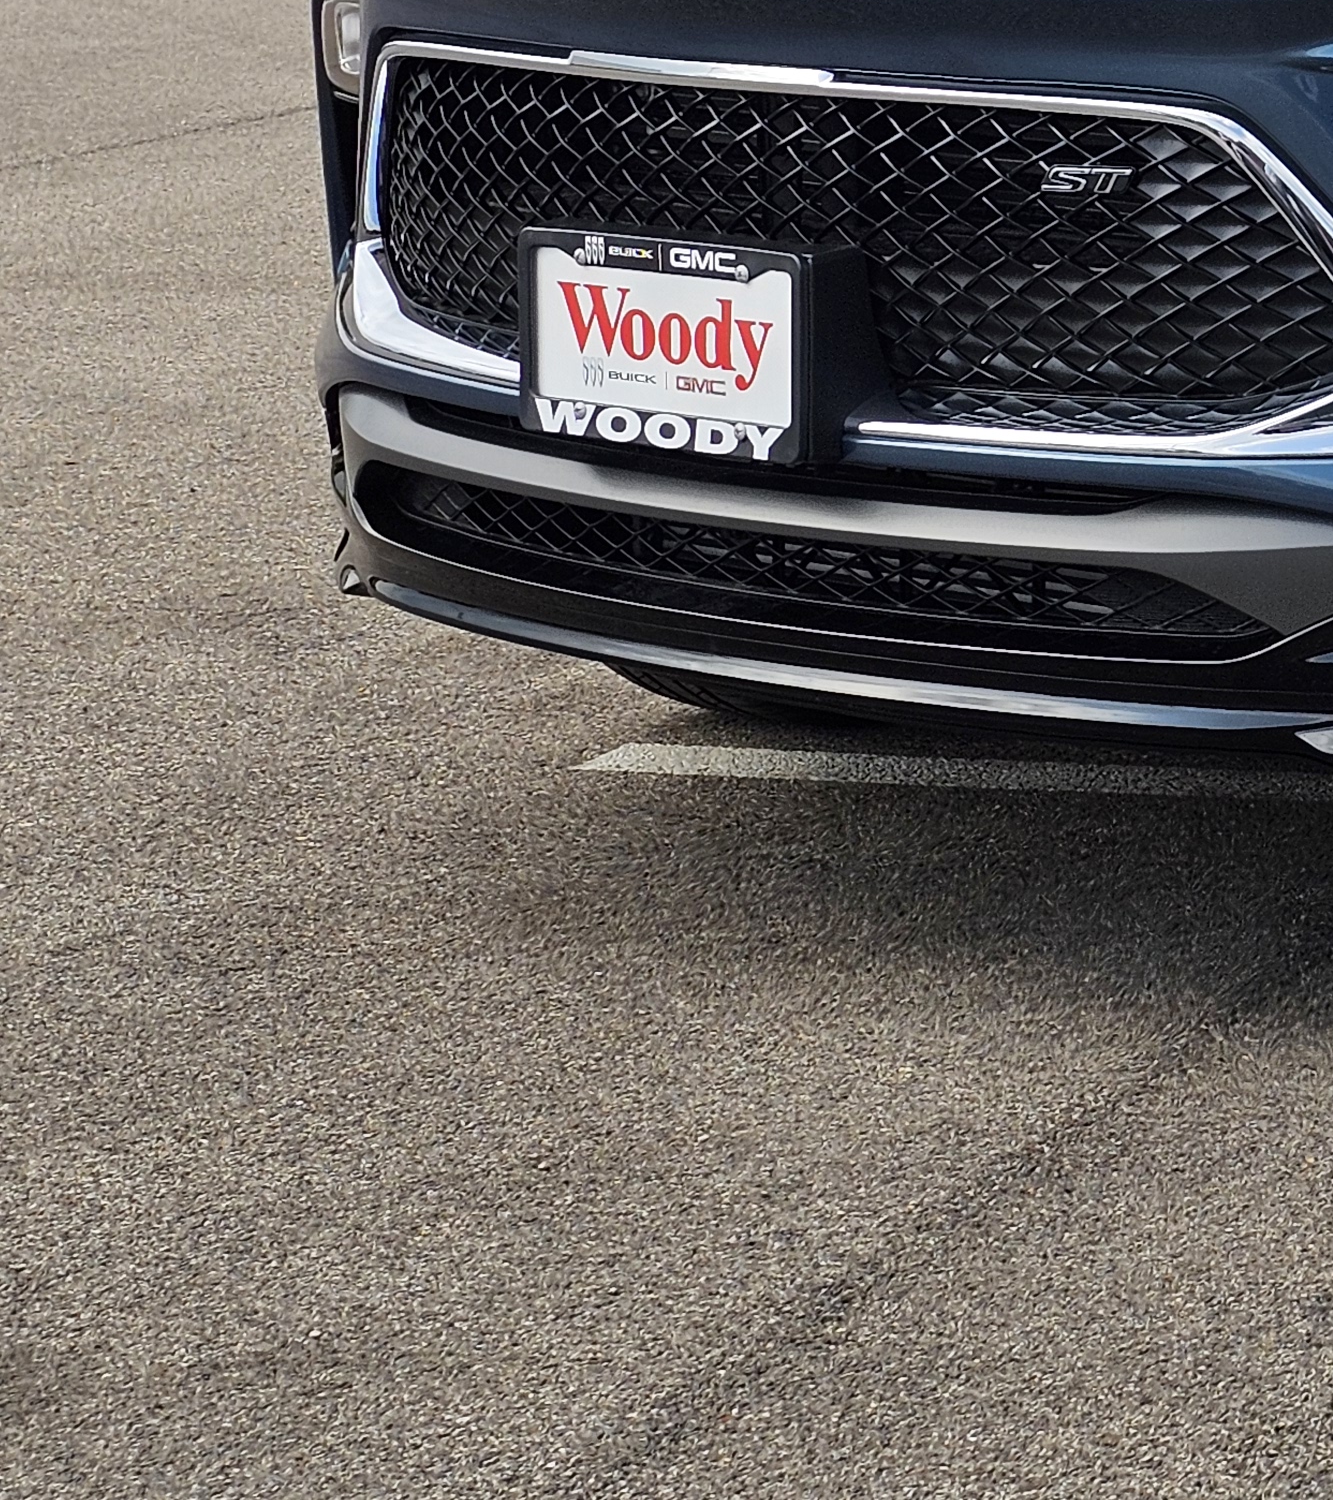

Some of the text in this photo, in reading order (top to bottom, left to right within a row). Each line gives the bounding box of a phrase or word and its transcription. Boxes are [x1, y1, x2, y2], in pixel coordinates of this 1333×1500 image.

[1041, 167, 1133, 194] ST
[608, 245, 739, 274] BUICK GMC
[557, 281, 774, 391] Woody
[608, 370, 727, 397] BUICK GMC
[534, 397, 784, 461] WOODY
